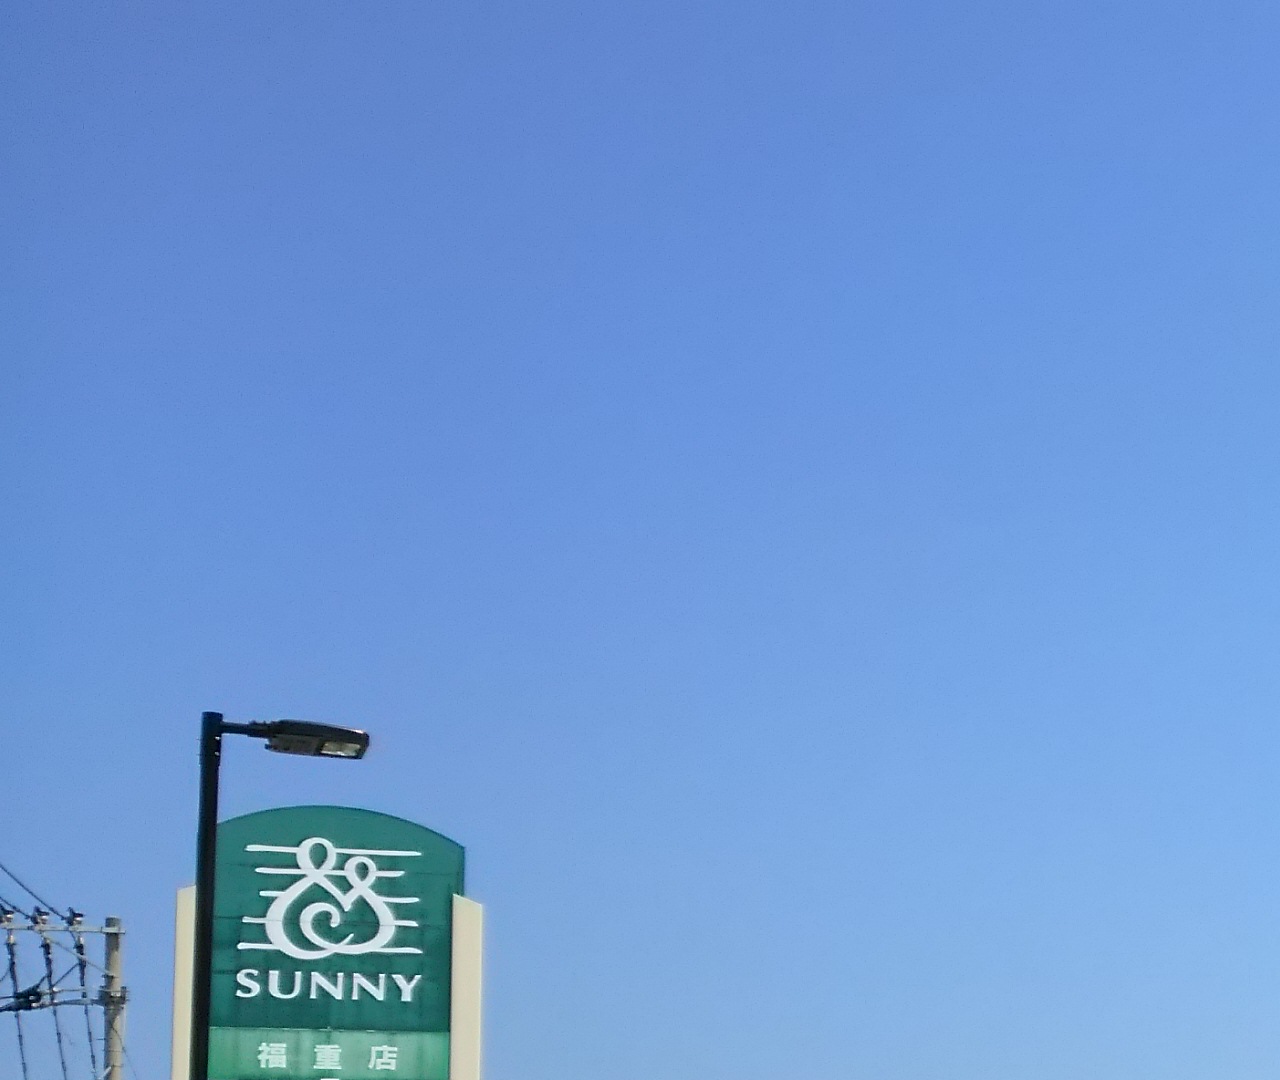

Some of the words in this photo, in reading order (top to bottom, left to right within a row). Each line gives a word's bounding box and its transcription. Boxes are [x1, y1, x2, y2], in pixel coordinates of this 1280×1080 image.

[235, 968, 422, 1002] SUNNY
[257, 1043, 398, 1071] 福重店
